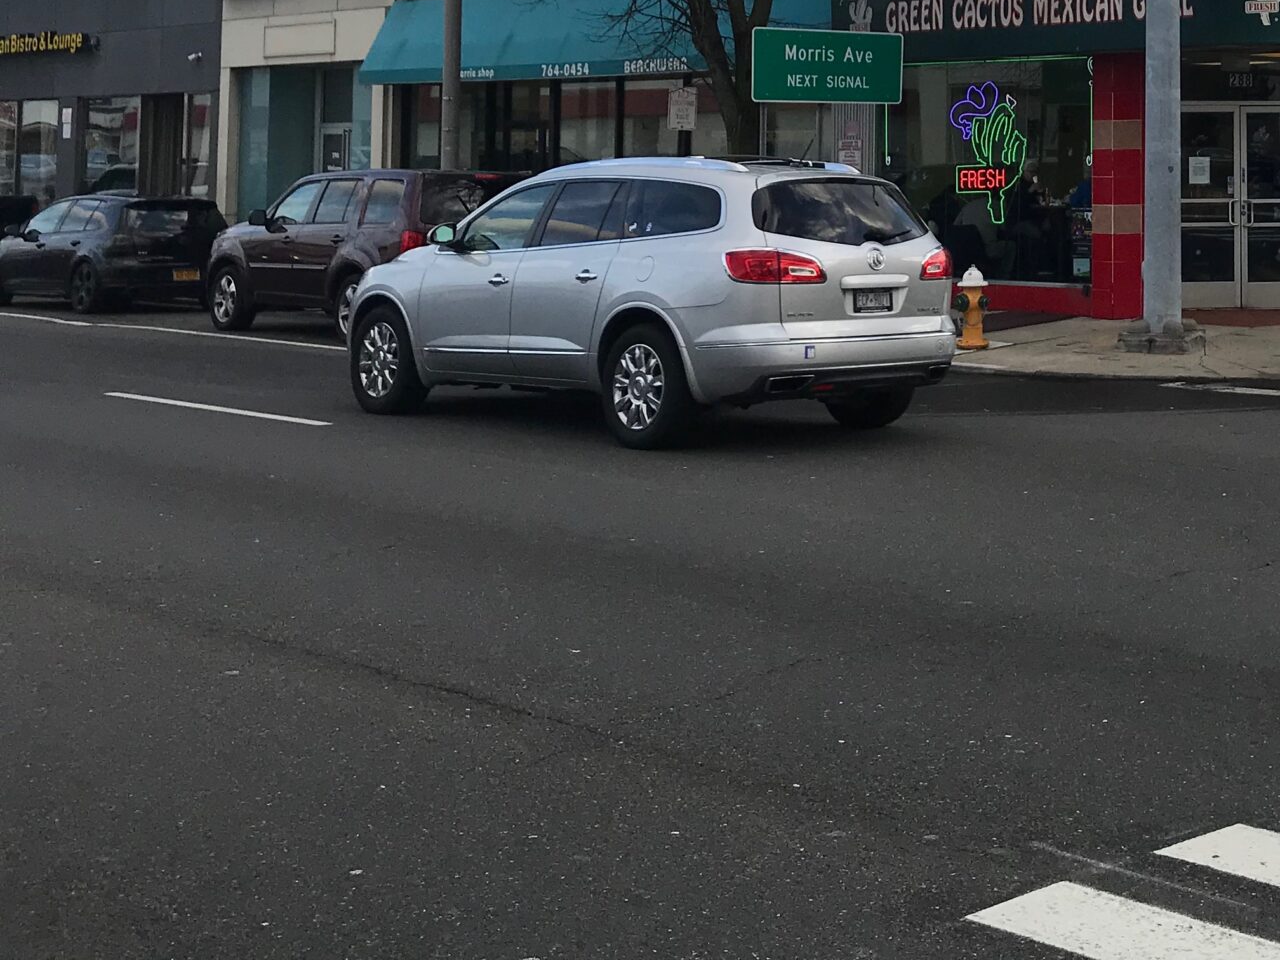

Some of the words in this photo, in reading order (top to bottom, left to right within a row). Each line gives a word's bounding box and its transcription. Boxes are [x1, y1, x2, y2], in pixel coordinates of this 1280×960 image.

[1248, 2, 1277, 12] FRESH
[10, 33, 38, 53] Bistro
[39, 31, 46, 51] &
[47, 31, 83, 54] Lounge
[785, 44, 835, 62] Morris
[843, 46, 873, 63] Ave
[477, 67, 495, 80] shop
[541, 62, 590, 78] 764-0454
[787, 74, 818, 88] NEXT
[826, 75, 870, 89] SIGNAL
[959, 169, 1006, 189] FRESH
